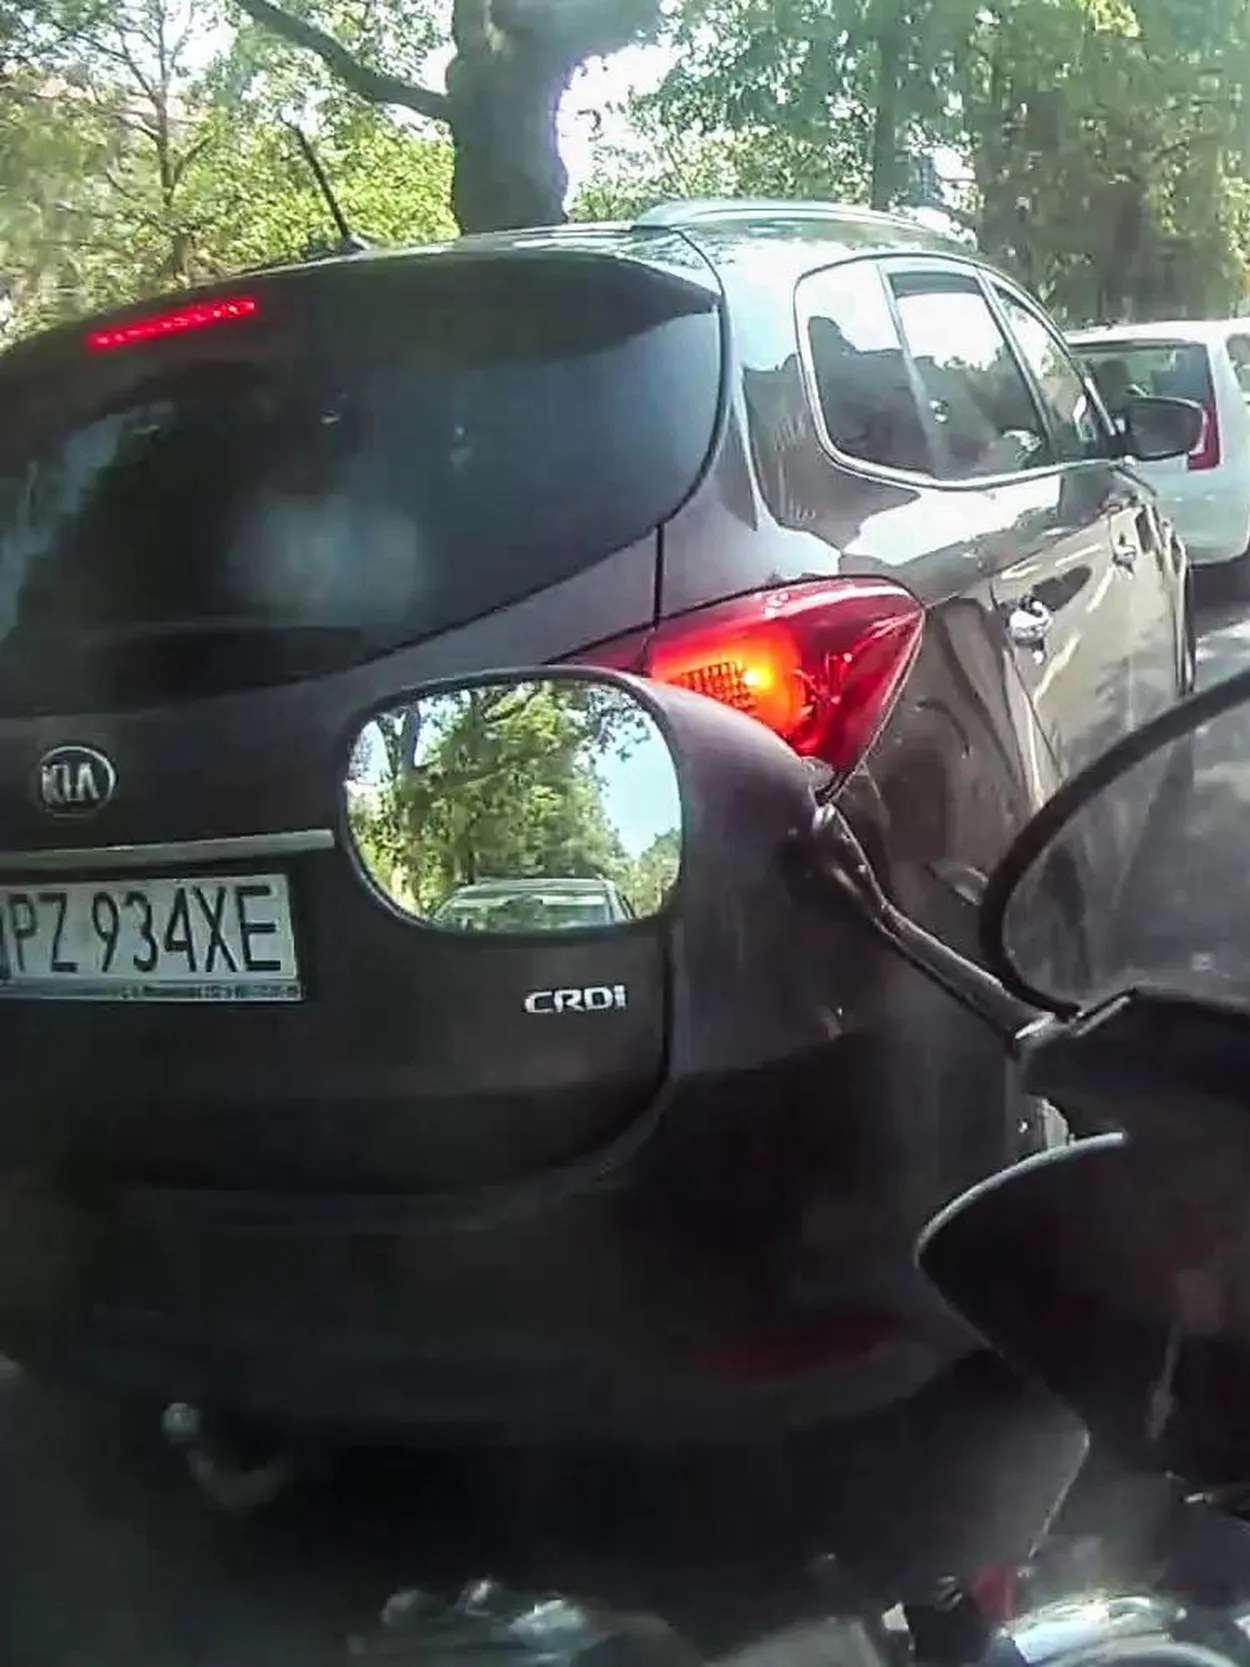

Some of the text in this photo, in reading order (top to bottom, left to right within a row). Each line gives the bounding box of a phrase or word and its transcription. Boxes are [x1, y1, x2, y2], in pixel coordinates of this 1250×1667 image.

[41, 762, 99, 803] KIA
[9, 885, 281, 973] PZ 934XE
